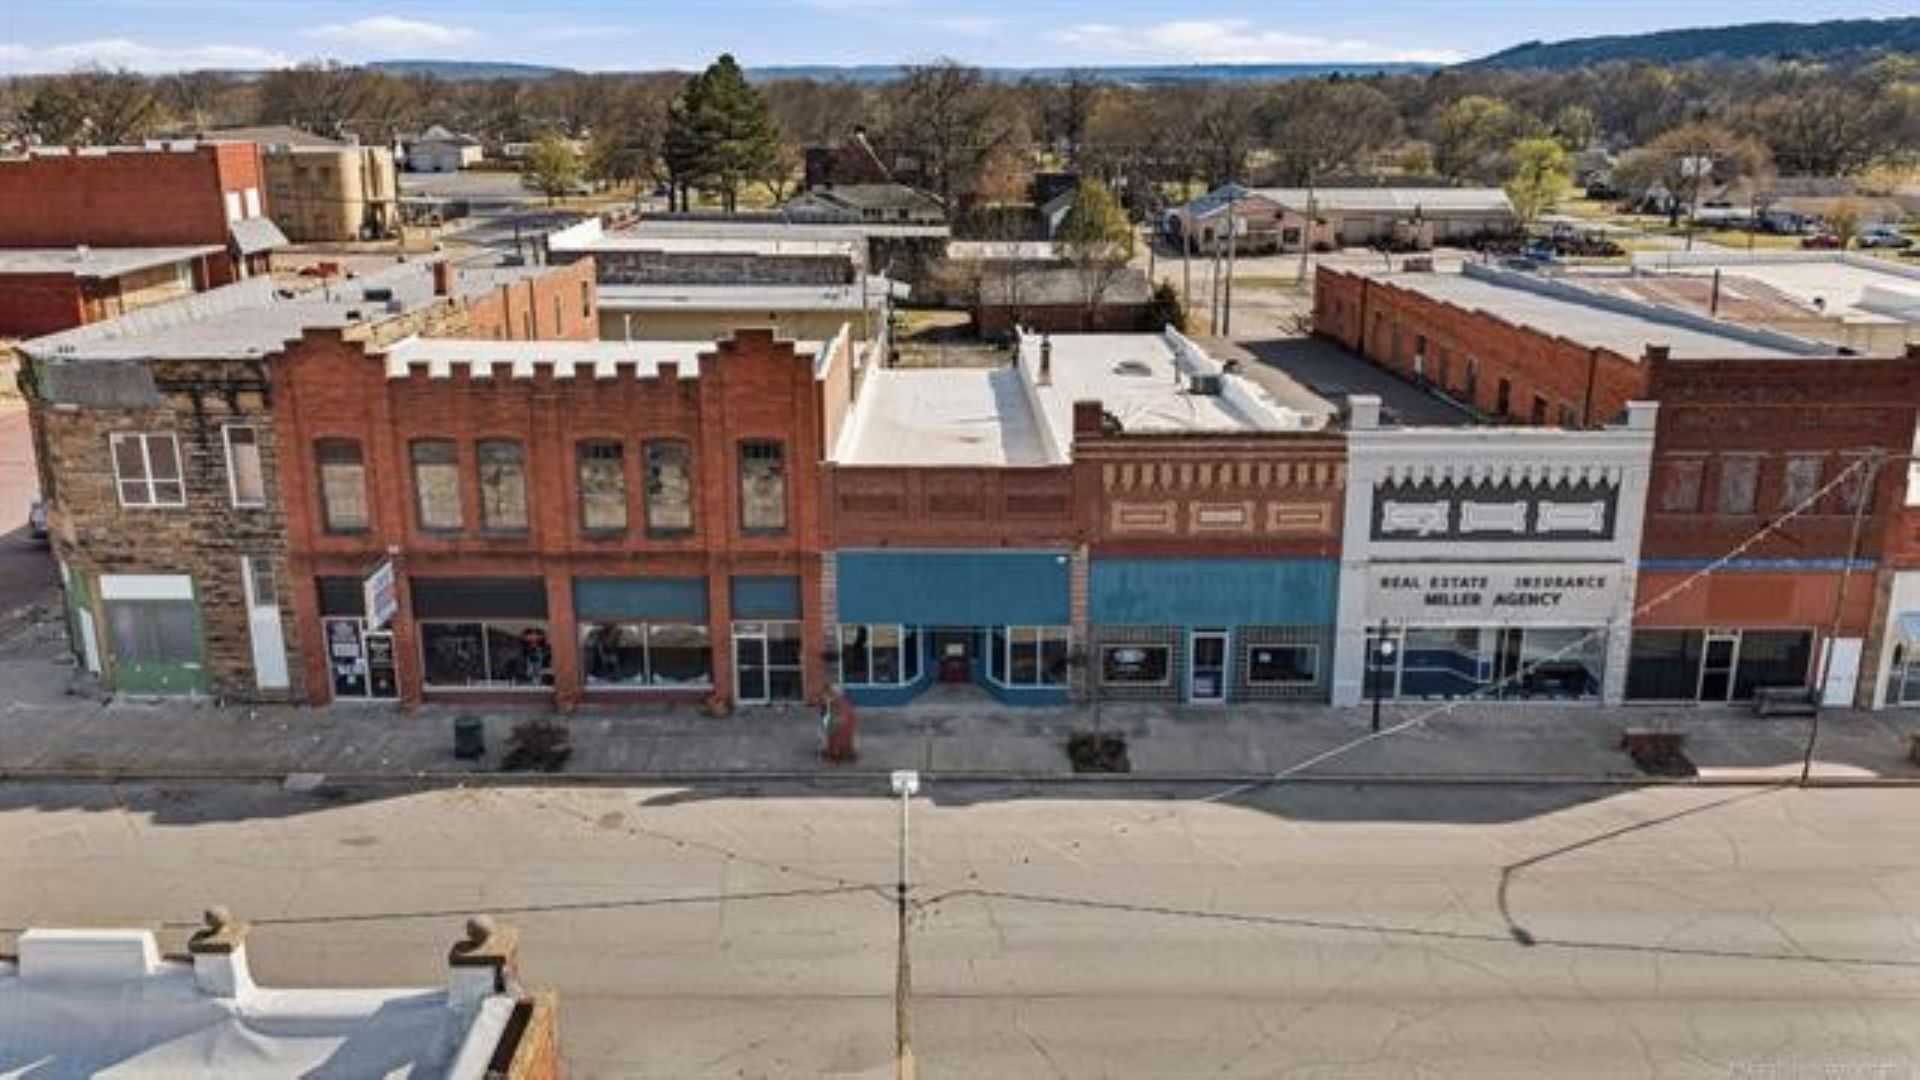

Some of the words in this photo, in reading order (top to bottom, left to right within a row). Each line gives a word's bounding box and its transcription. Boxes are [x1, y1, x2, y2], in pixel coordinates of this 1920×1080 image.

[1380, 576, 1419, 588] REAL
[1430, 576, 1488, 588] ESTATE
[1514, 576, 1606, 588] INSURANCE
[1424, 592, 1482, 606] MILLER
[1493, 592, 1562, 606] AGENCY
